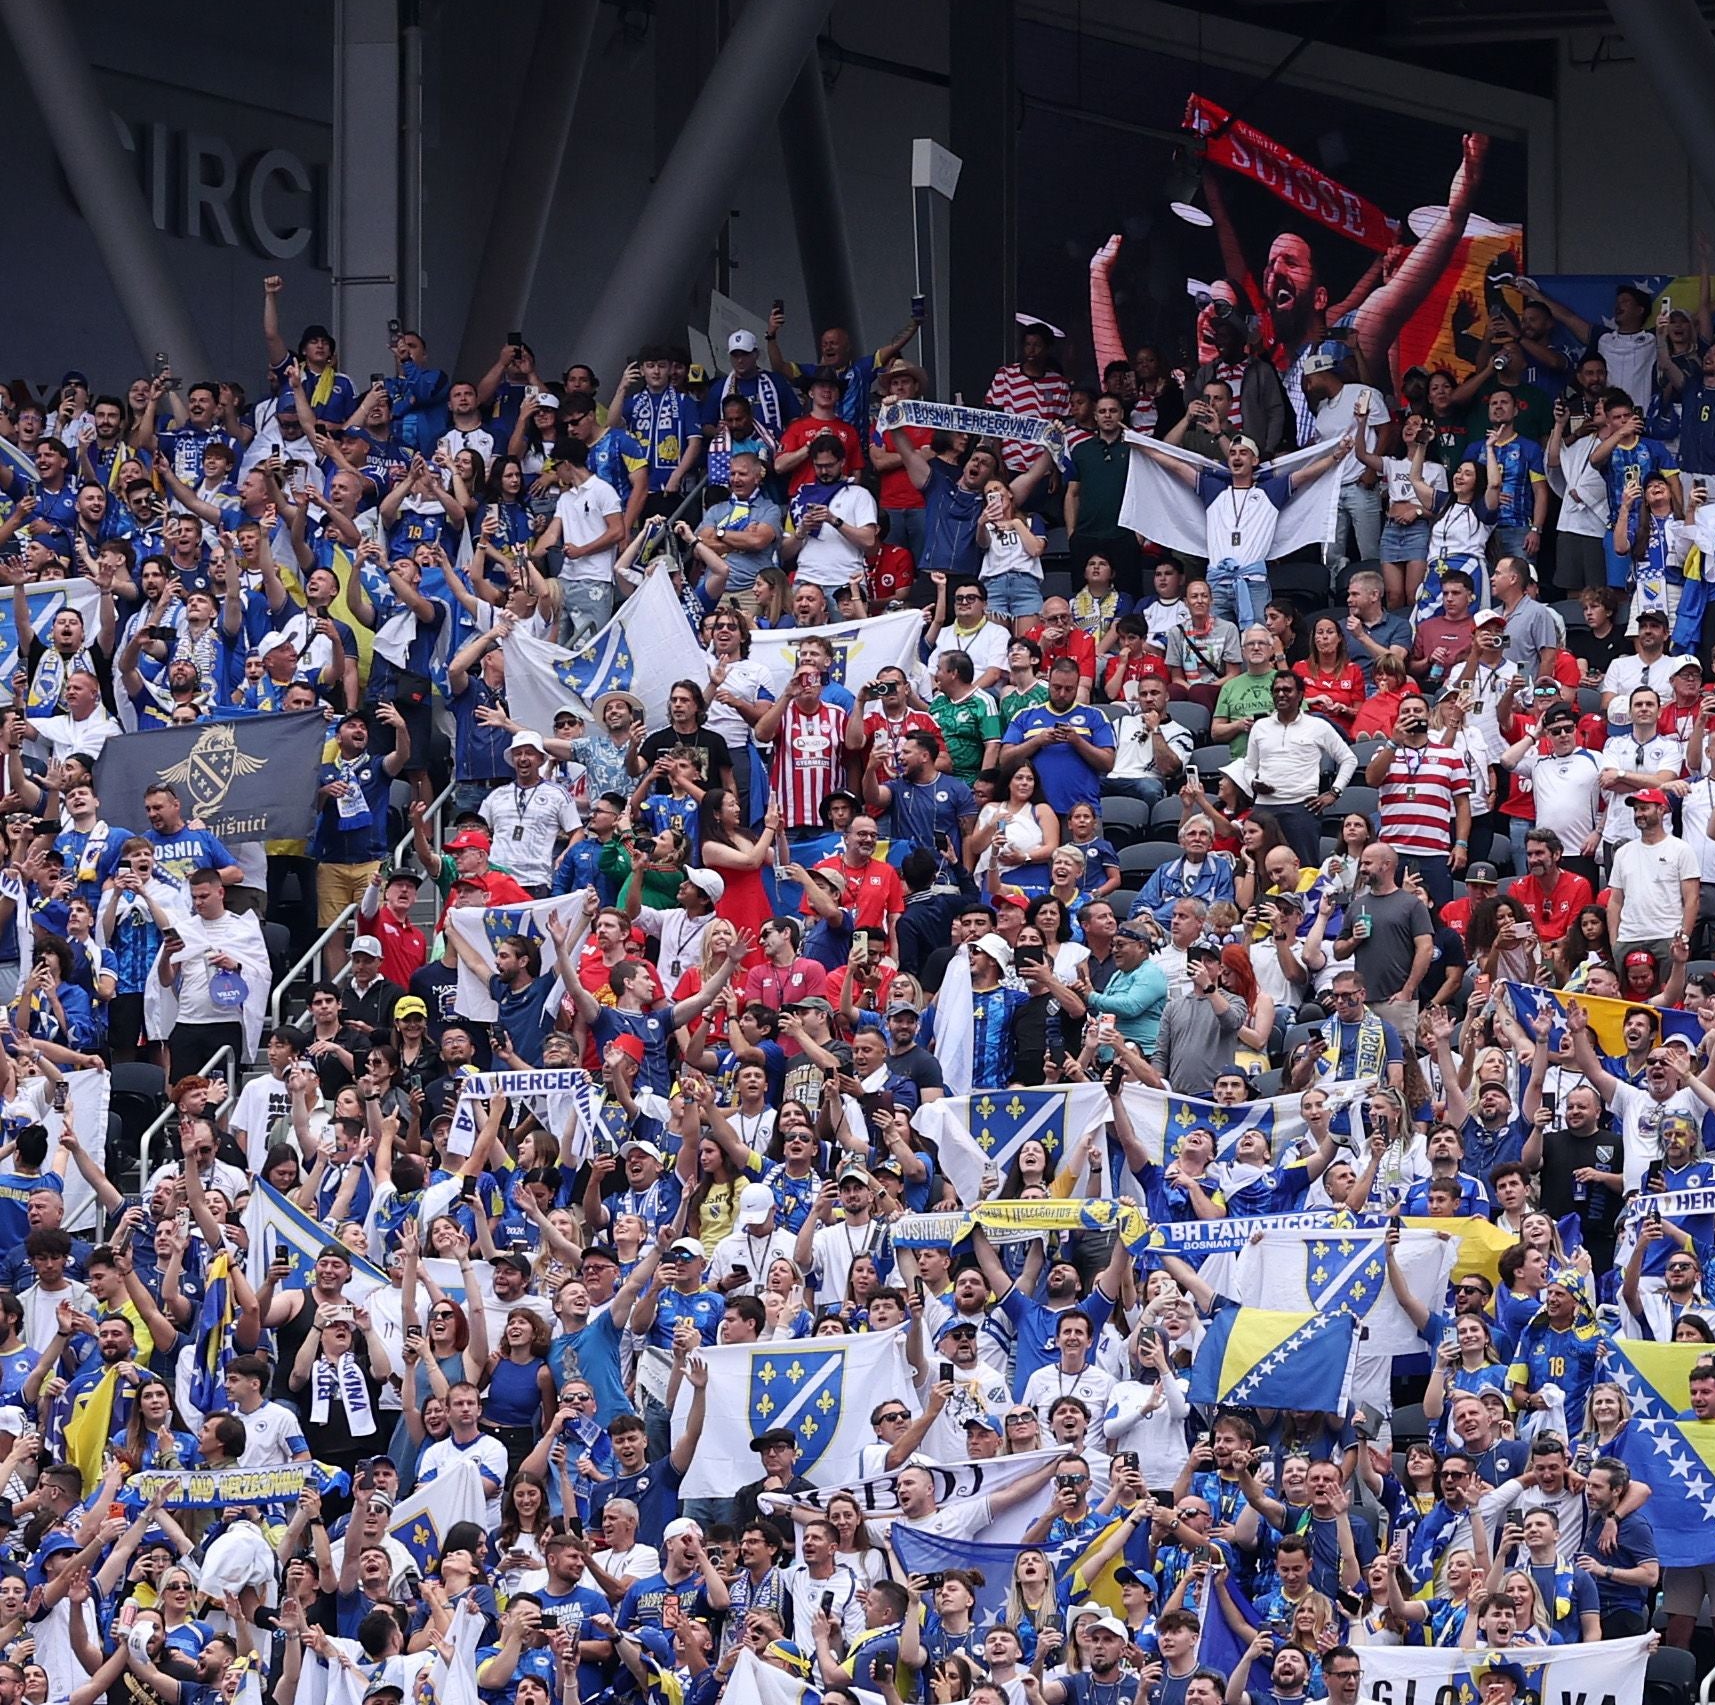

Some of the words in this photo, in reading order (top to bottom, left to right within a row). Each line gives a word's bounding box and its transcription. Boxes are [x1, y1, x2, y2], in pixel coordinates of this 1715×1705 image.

[1231, 135, 1384, 237] SUISSE
[913, 405, 947, 424] BOSNA
[955, 410, 1035, 439] HERCEGOVINA
[1701, 405, 1710, 421] 6
[1001, 532, 1017, 546] 20
[154, 840, 203, 861] OSNIA
[1173, 1223, 1206, 1242] BH
[1210, 1214, 1327, 1240] FANATICOS
[384, 1320, 395, 1338] 11
[1548, 1356, 1565, 1378] 18
